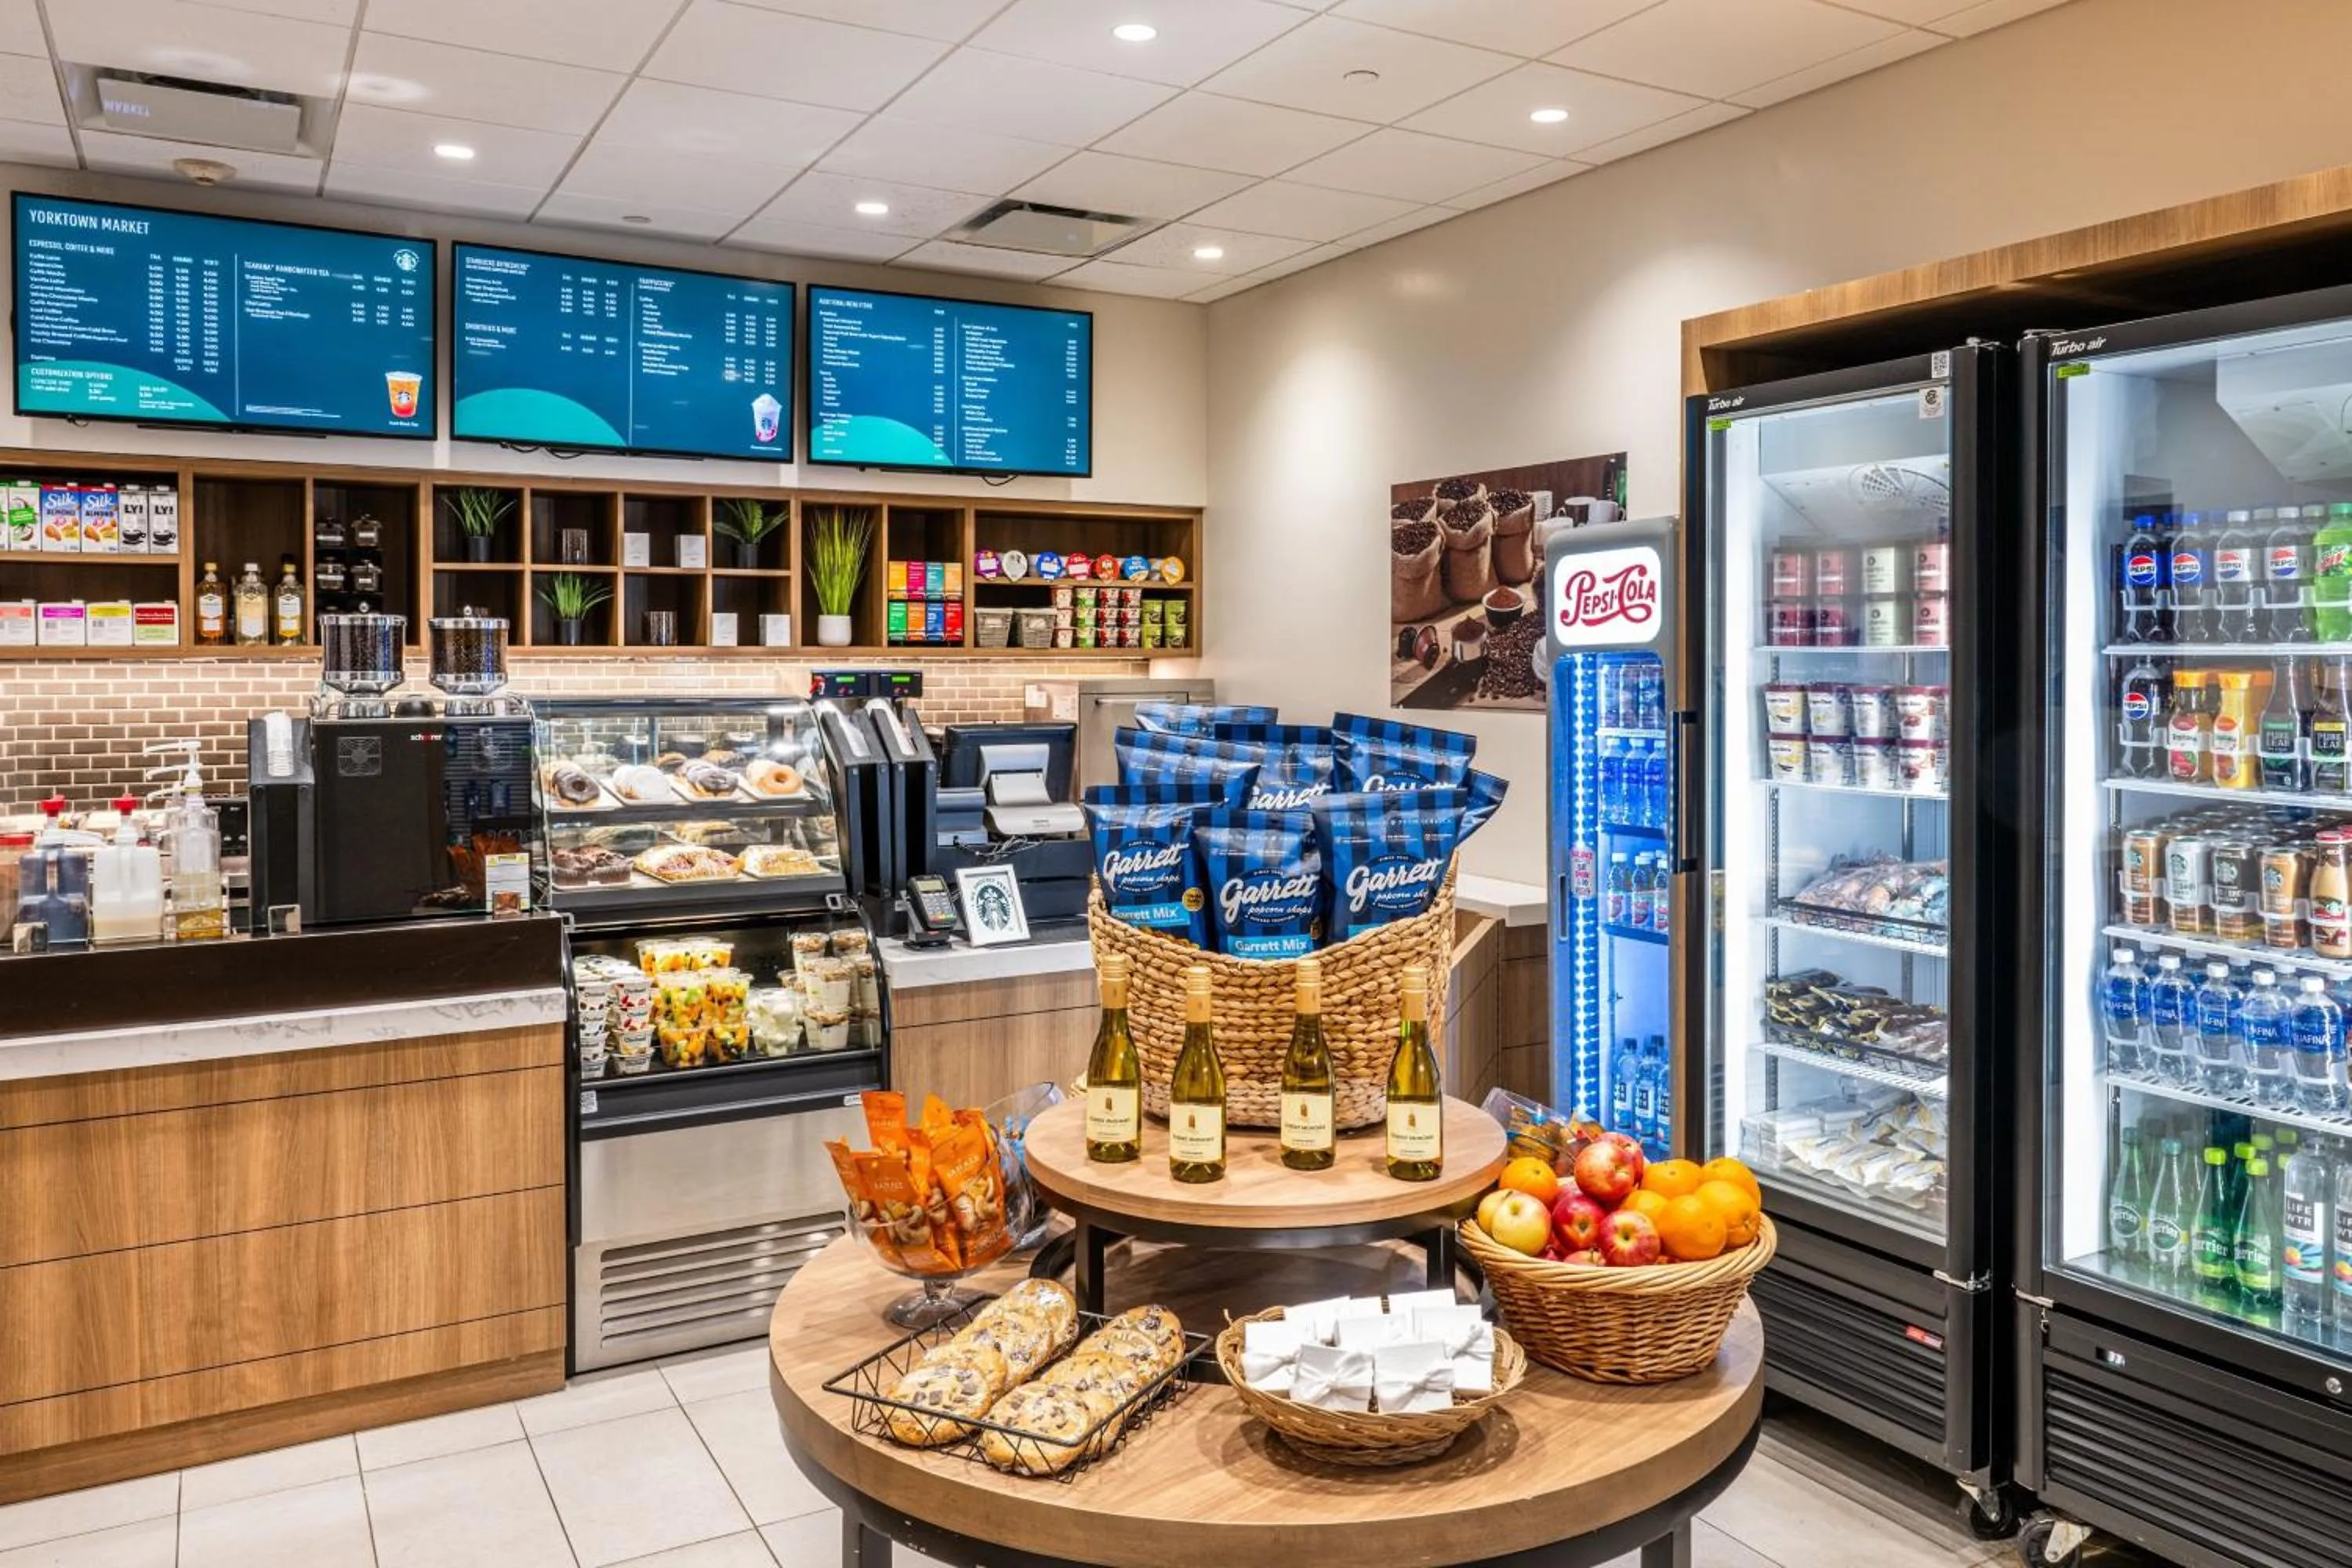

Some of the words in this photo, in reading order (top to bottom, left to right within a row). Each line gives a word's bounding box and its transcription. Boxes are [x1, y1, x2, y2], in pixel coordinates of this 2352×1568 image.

[29, 209, 98, 229] YORKTOWN
[101, 218, 150, 234] MARKET
[2052, 339, 2086, 356] Turbo
[2087, 336, 2107, 350] air
[45, 492, 77, 508] Silk
[83, 493, 115, 510] Silk
[1103, 843, 1190, 893] Garrett
[1346, 858, 1445, 913] Garrett
[1219, 873, 1319, 924] Garrett
[1152, 906, 1180, 919] Mix
[1235, 940, 1280, 952] Garrett
[1282, 938, 1307, 951] Mix
[2287, 1200, 2312, 1215] LIFE
[2287, 1213, 2312, 1227] WTR
